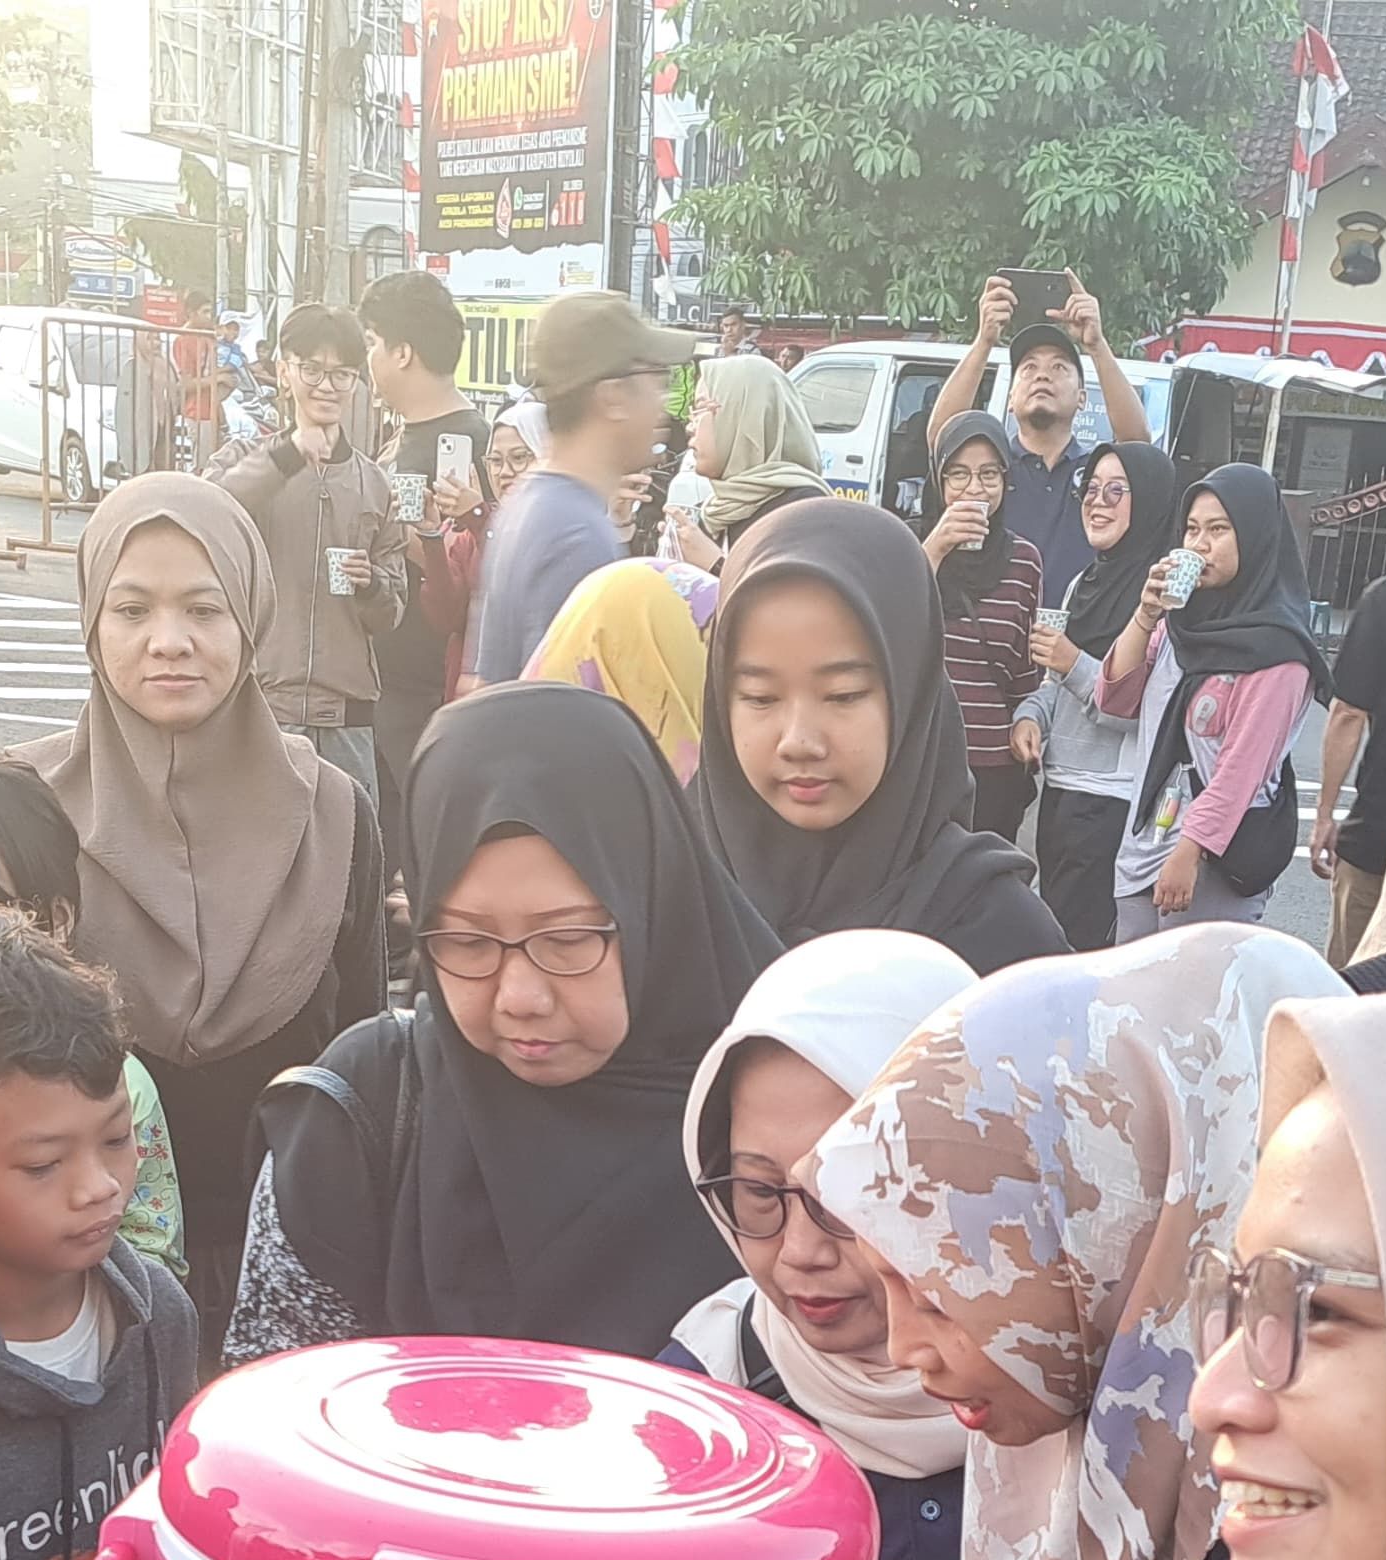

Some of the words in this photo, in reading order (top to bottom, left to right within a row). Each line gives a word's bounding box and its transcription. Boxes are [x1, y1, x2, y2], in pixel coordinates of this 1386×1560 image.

[457, 0, 511, 57] STOP
[512, 0, 566, 47] AKSI
[441, 47, 580, 128] PREMANISME!
